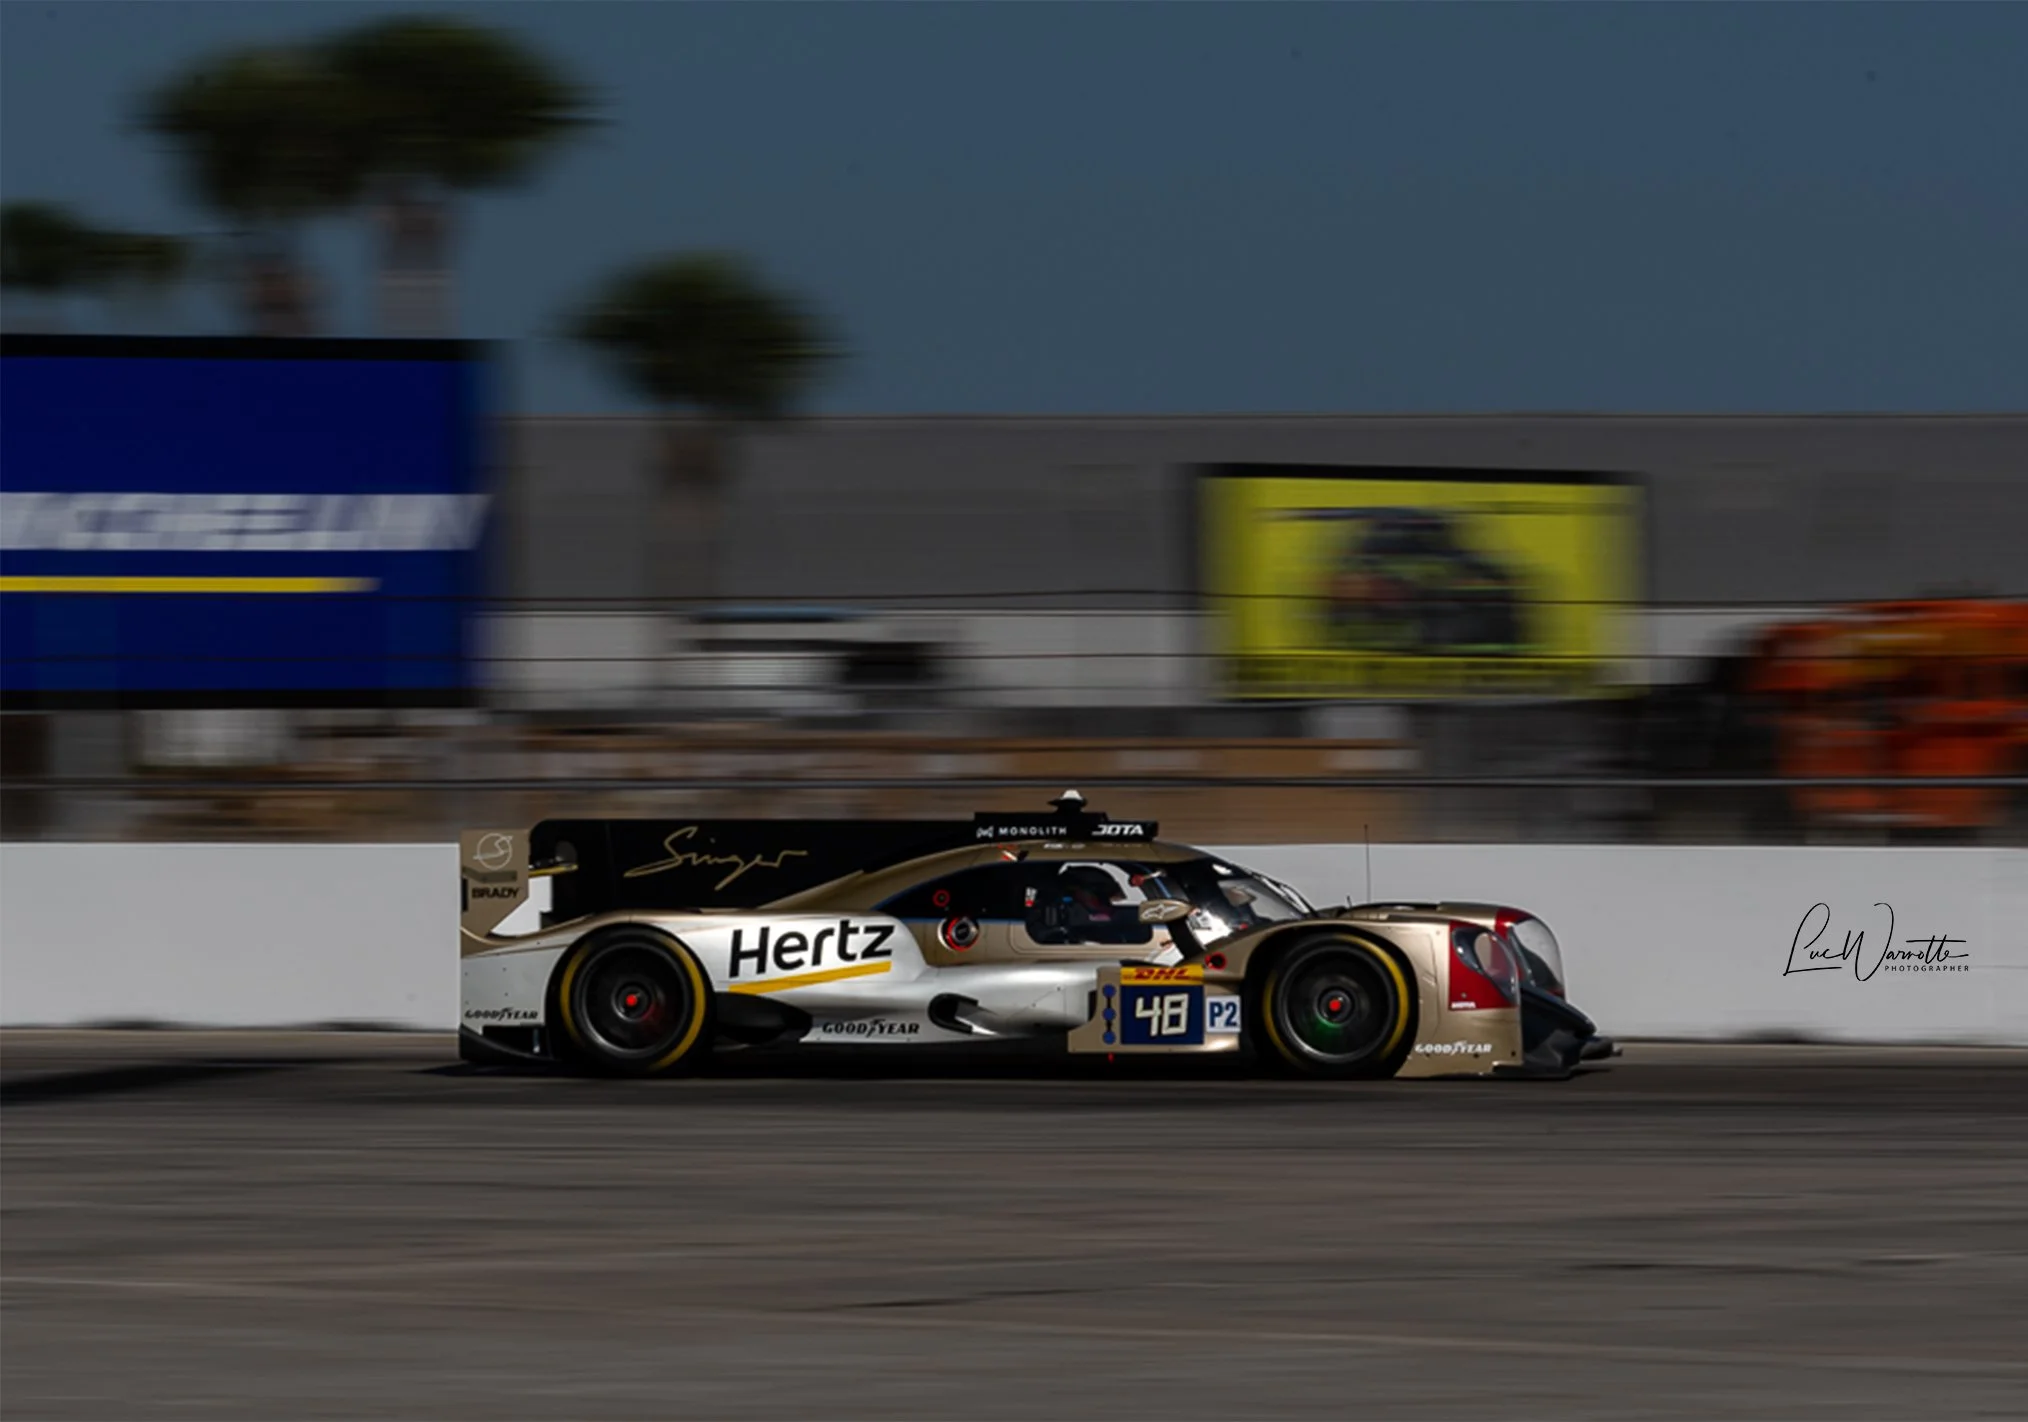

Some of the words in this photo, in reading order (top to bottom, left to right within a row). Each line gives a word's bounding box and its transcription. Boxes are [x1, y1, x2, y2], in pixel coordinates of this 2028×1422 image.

[999, 826, 1067, 835] MONOLITH
[1091, 824, 1144, 836] JOTA
[623, 826, 808, 891] Singer
[471, 887, 521, 899] BRADY
[727, 919, 895, 979] Hertz
[1135, 967, 1190, 981] DHL
[464, 1006, 539, 1021] GOODYEAR
[1135, 992, 1190, 1037] 48
[1208, 1001, 1239, 1028] P2
[822, 1017, 920, 1038] GOODYEAR
[1414, 1040, 1493, 1056] GOODYEAR
